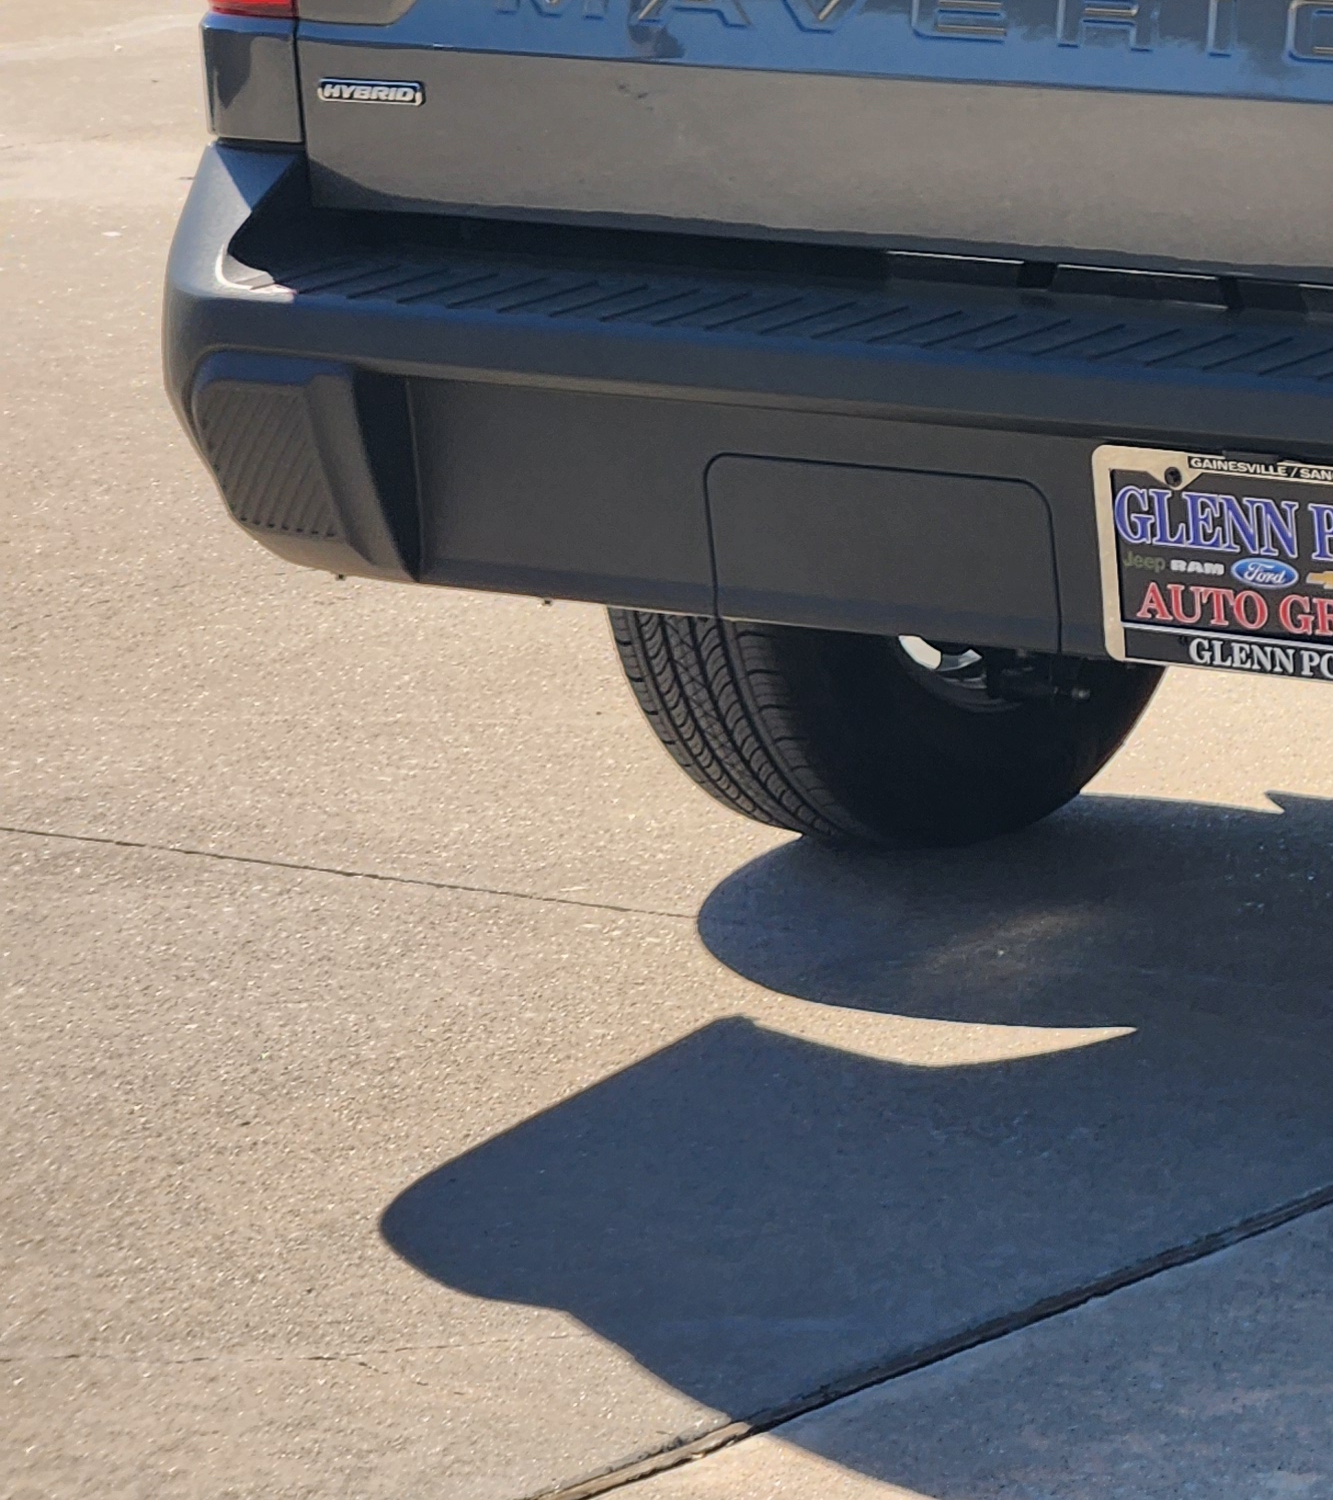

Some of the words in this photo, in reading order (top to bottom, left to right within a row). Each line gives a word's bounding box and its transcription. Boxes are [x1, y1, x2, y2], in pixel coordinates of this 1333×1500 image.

[323, 83, 414, 101] HYBRID
[1189, 457, 1288, 477] GAINESVILLE
[1114, 485, 1298, 559] GLENN
[1123, 550, 1166, 574] Jeep
[1169, 558, 1225, 576] RAM
[1242, 560, 1288, 586] Ford
[1136, 581, 1269, 630] AUTO
[1188, 638, 1298, 675] GLENN
